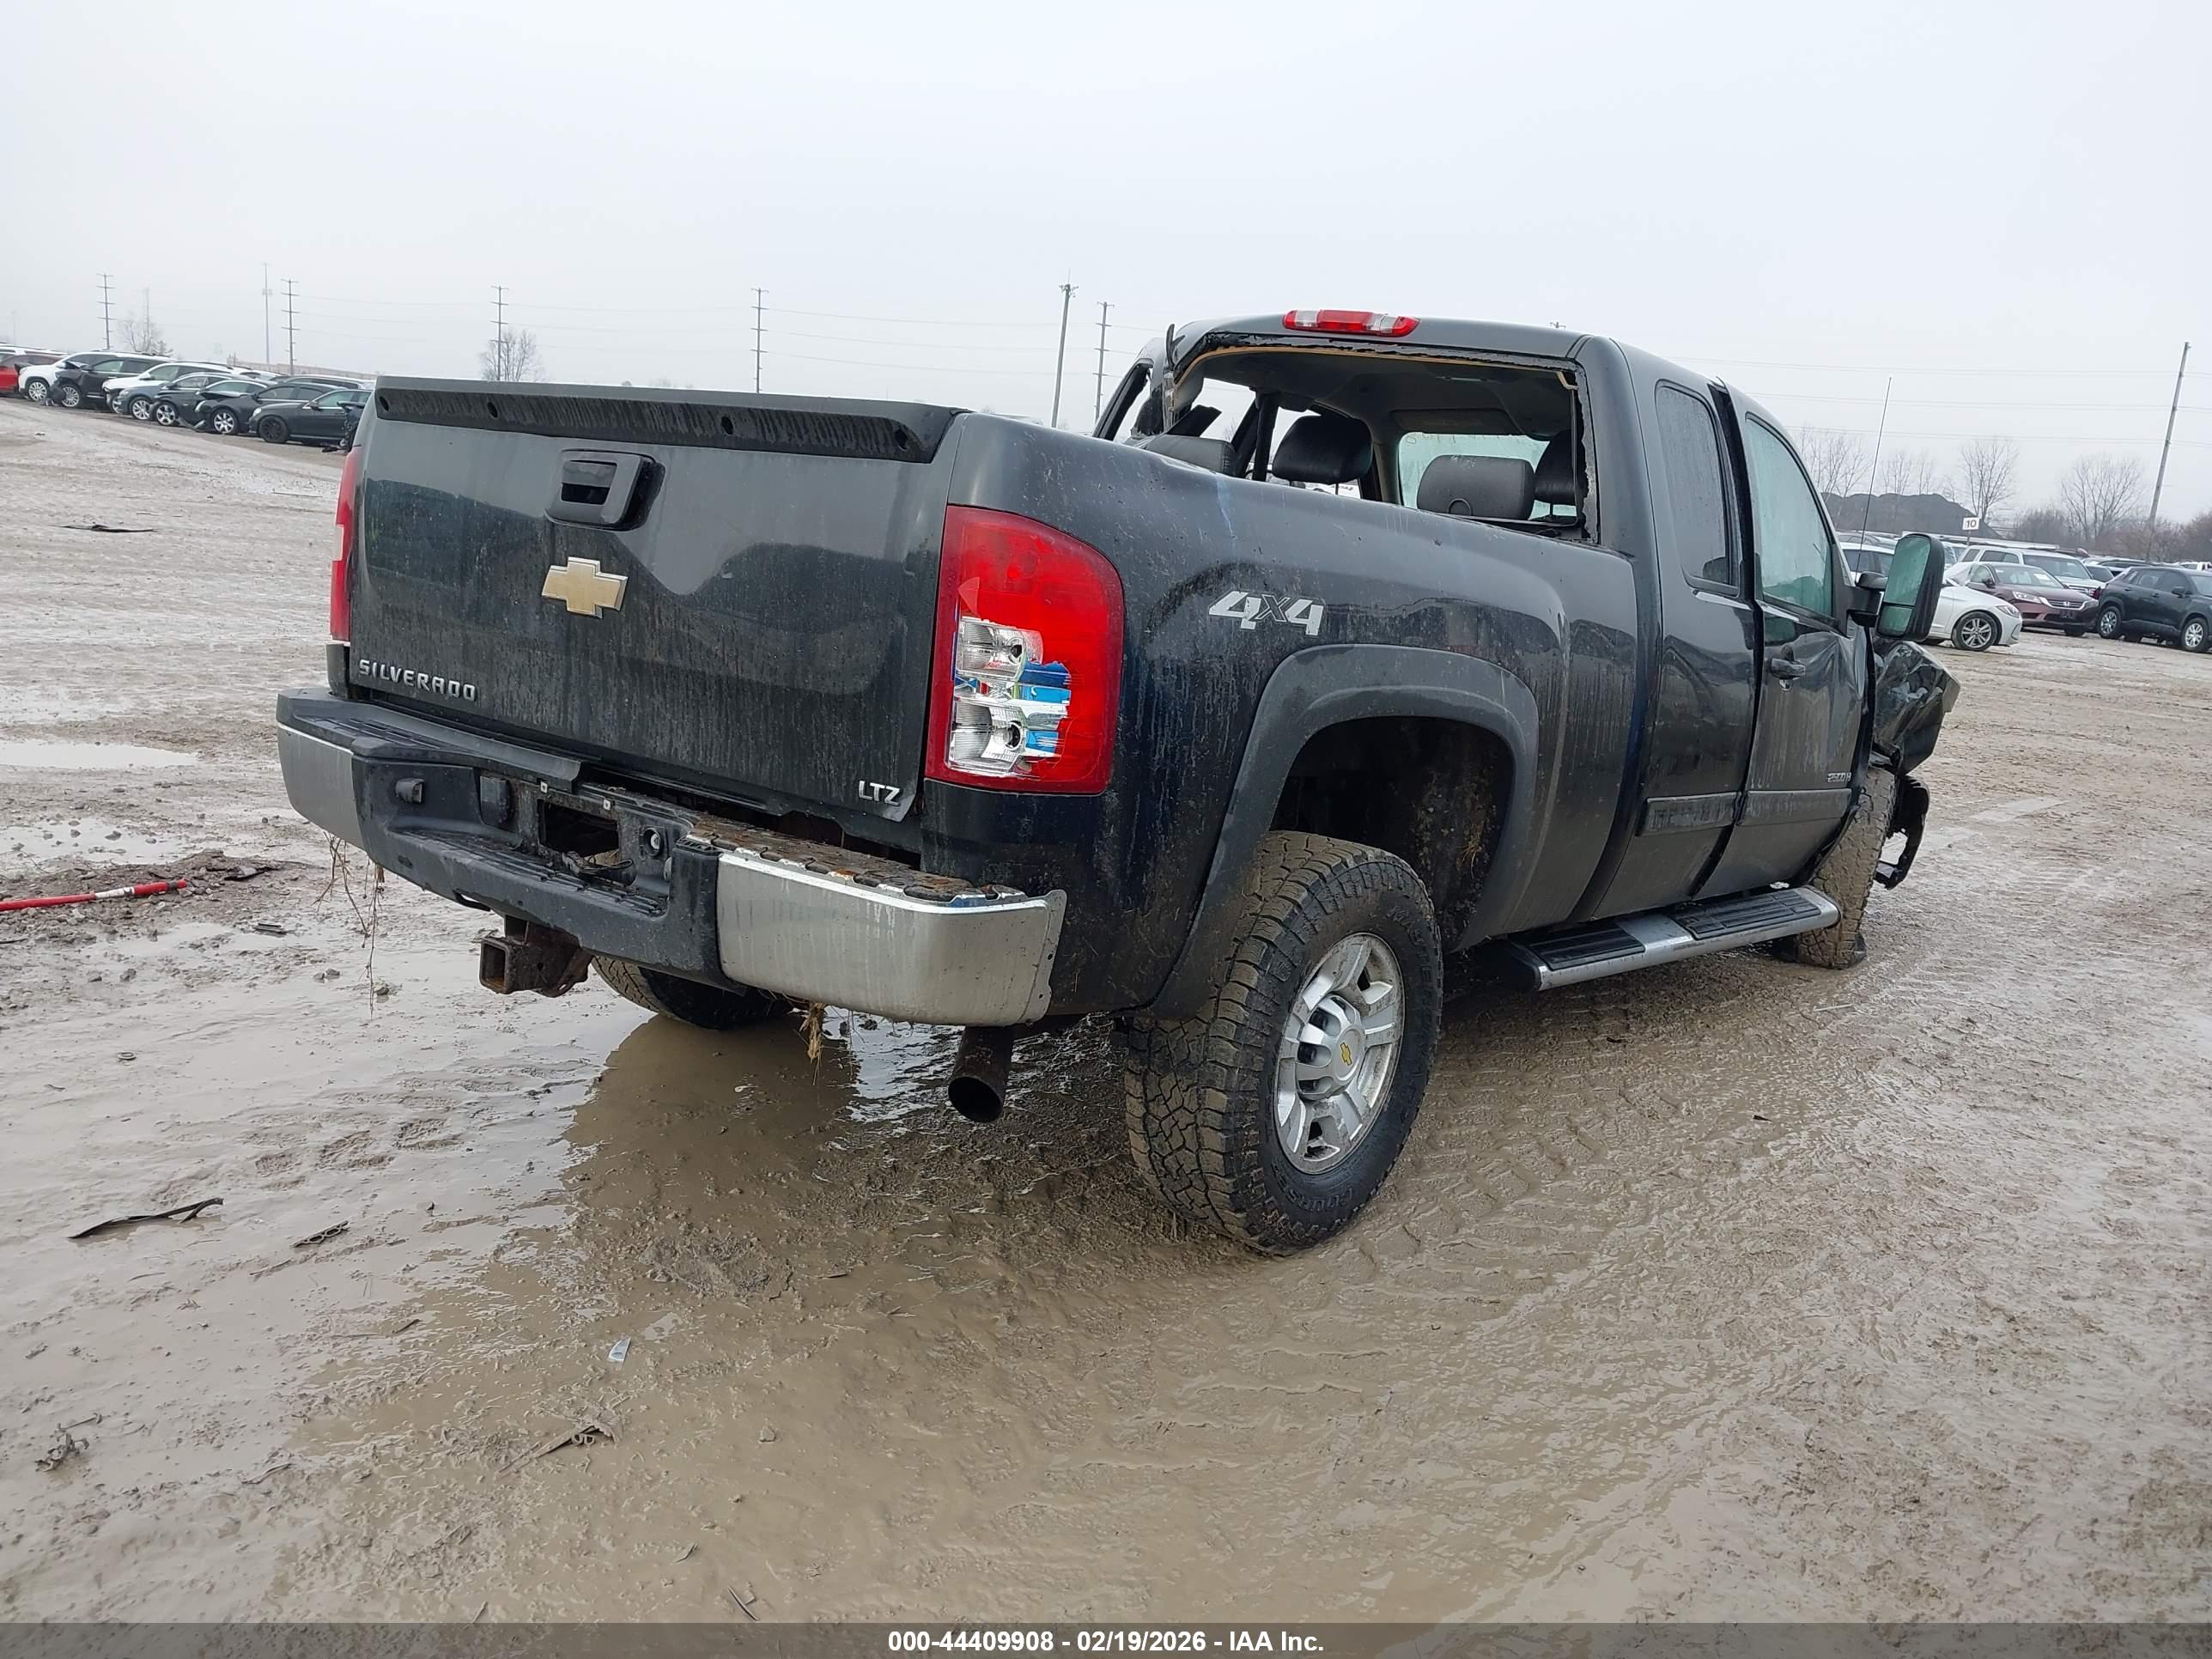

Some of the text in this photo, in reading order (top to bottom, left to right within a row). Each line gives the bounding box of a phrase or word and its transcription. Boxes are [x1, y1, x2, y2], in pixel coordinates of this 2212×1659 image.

[1966, 519, 1977, 528] 10
[359, 659, 476, 702] SILVERADO
[859, 780, 901, 805] LTZ
